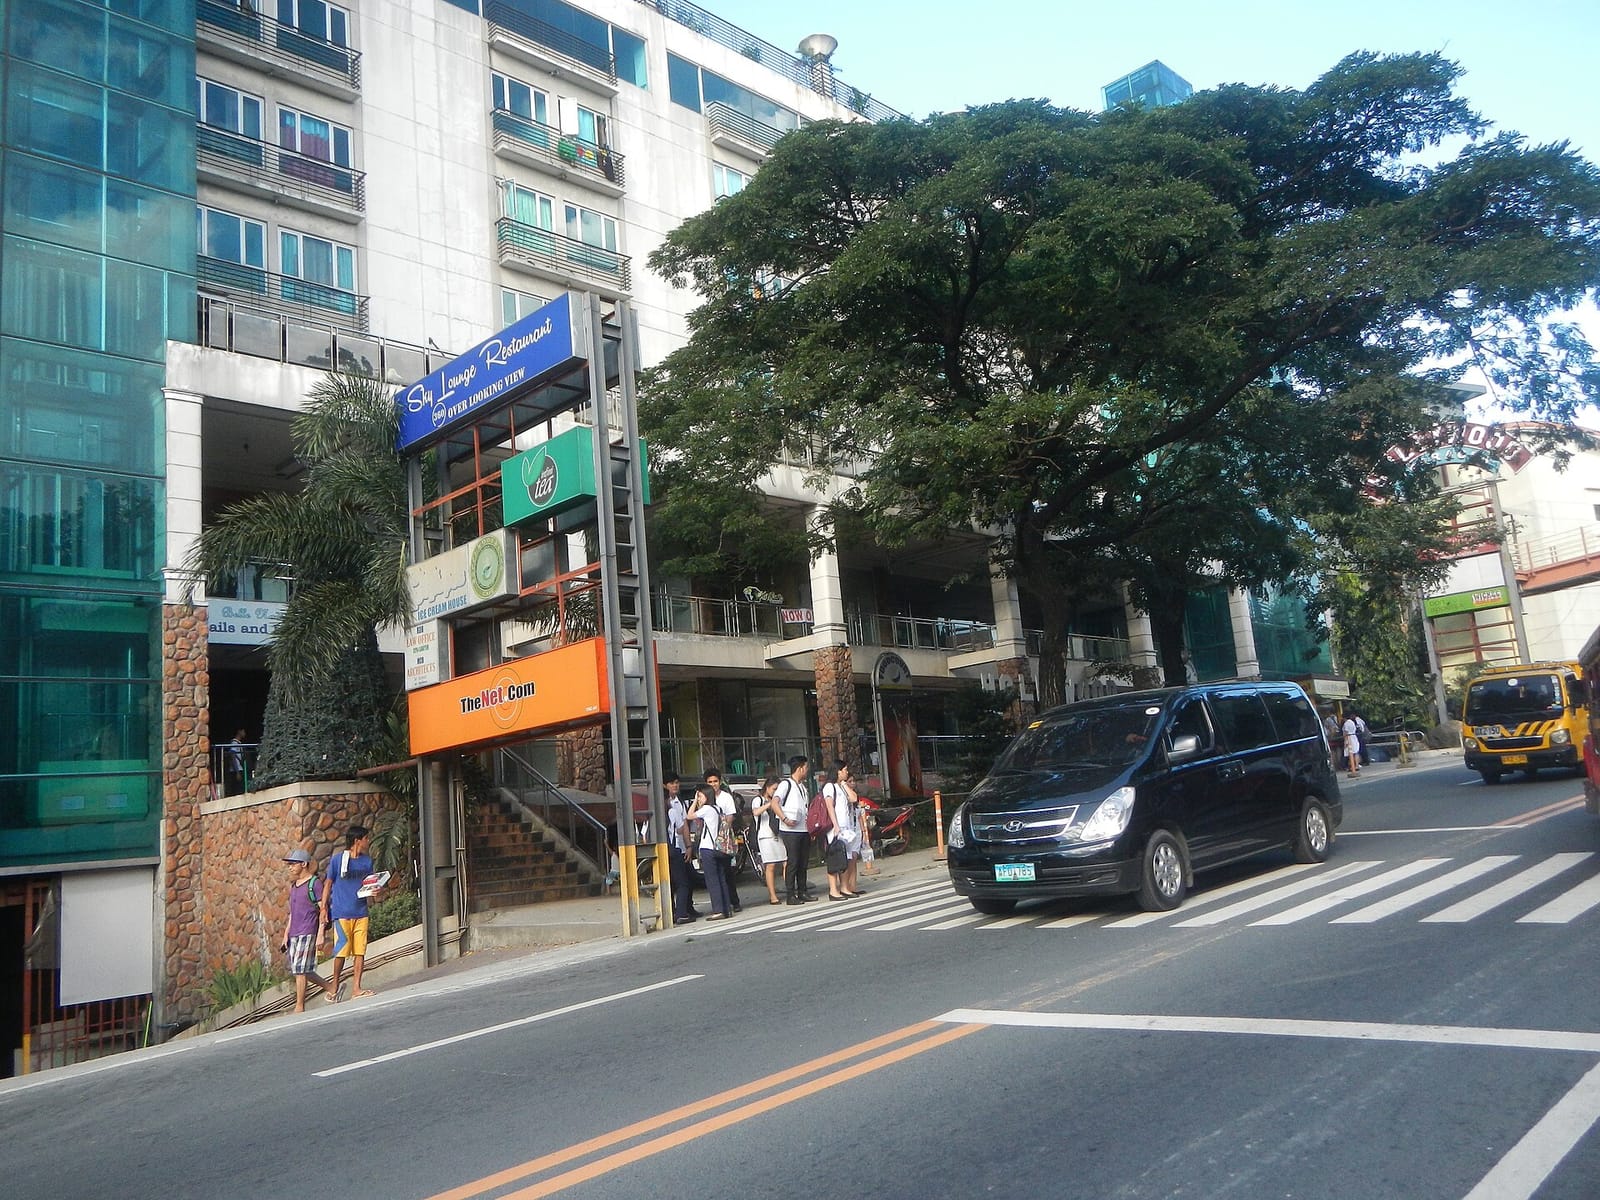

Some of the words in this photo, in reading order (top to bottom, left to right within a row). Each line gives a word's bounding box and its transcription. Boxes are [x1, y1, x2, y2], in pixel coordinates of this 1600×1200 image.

[407, 384, 433, 413] Sky
[437, 364, 477, 402] Lounge
[479, 317, 553, 370] Restaurant
[433, 408, 446, 422] 360
[448, 400, 467, 418] OVER
[469, 379, 503, 407] LOOKING
[504, 367, 526, 389] VIEW
[535, 475, 554, 499] tea
[417, 608, 427, 620] ICE
[428, 602, 447, 617] CREAM
[447, 595, 467, 611] HOUSE
[782, 609, 803, 622] NOW
[209, 622, 235, 633] ails
[241, 624, 269, 634] and
[417, 632, 435, 645] OFFICE
